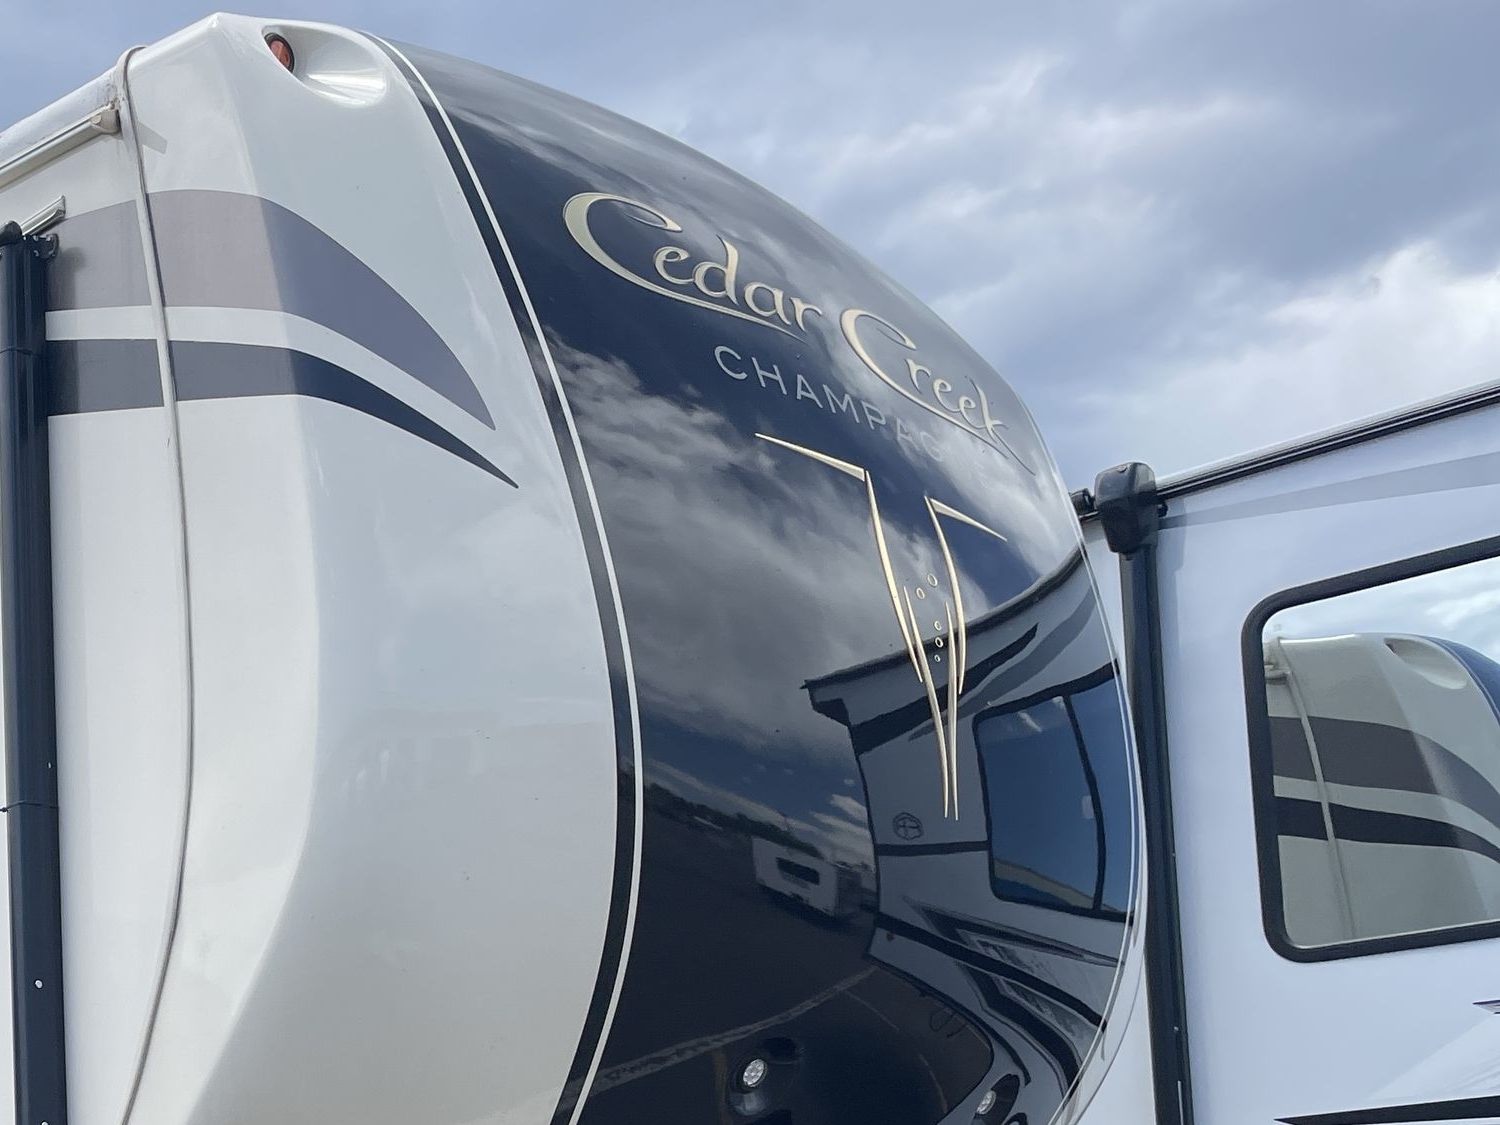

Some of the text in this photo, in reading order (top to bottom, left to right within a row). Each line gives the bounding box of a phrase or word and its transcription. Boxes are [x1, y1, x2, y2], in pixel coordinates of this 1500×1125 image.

[563, 191, 1036, 476] Cedar Creek
[714, 345, 988, 486] CHAMPAG
